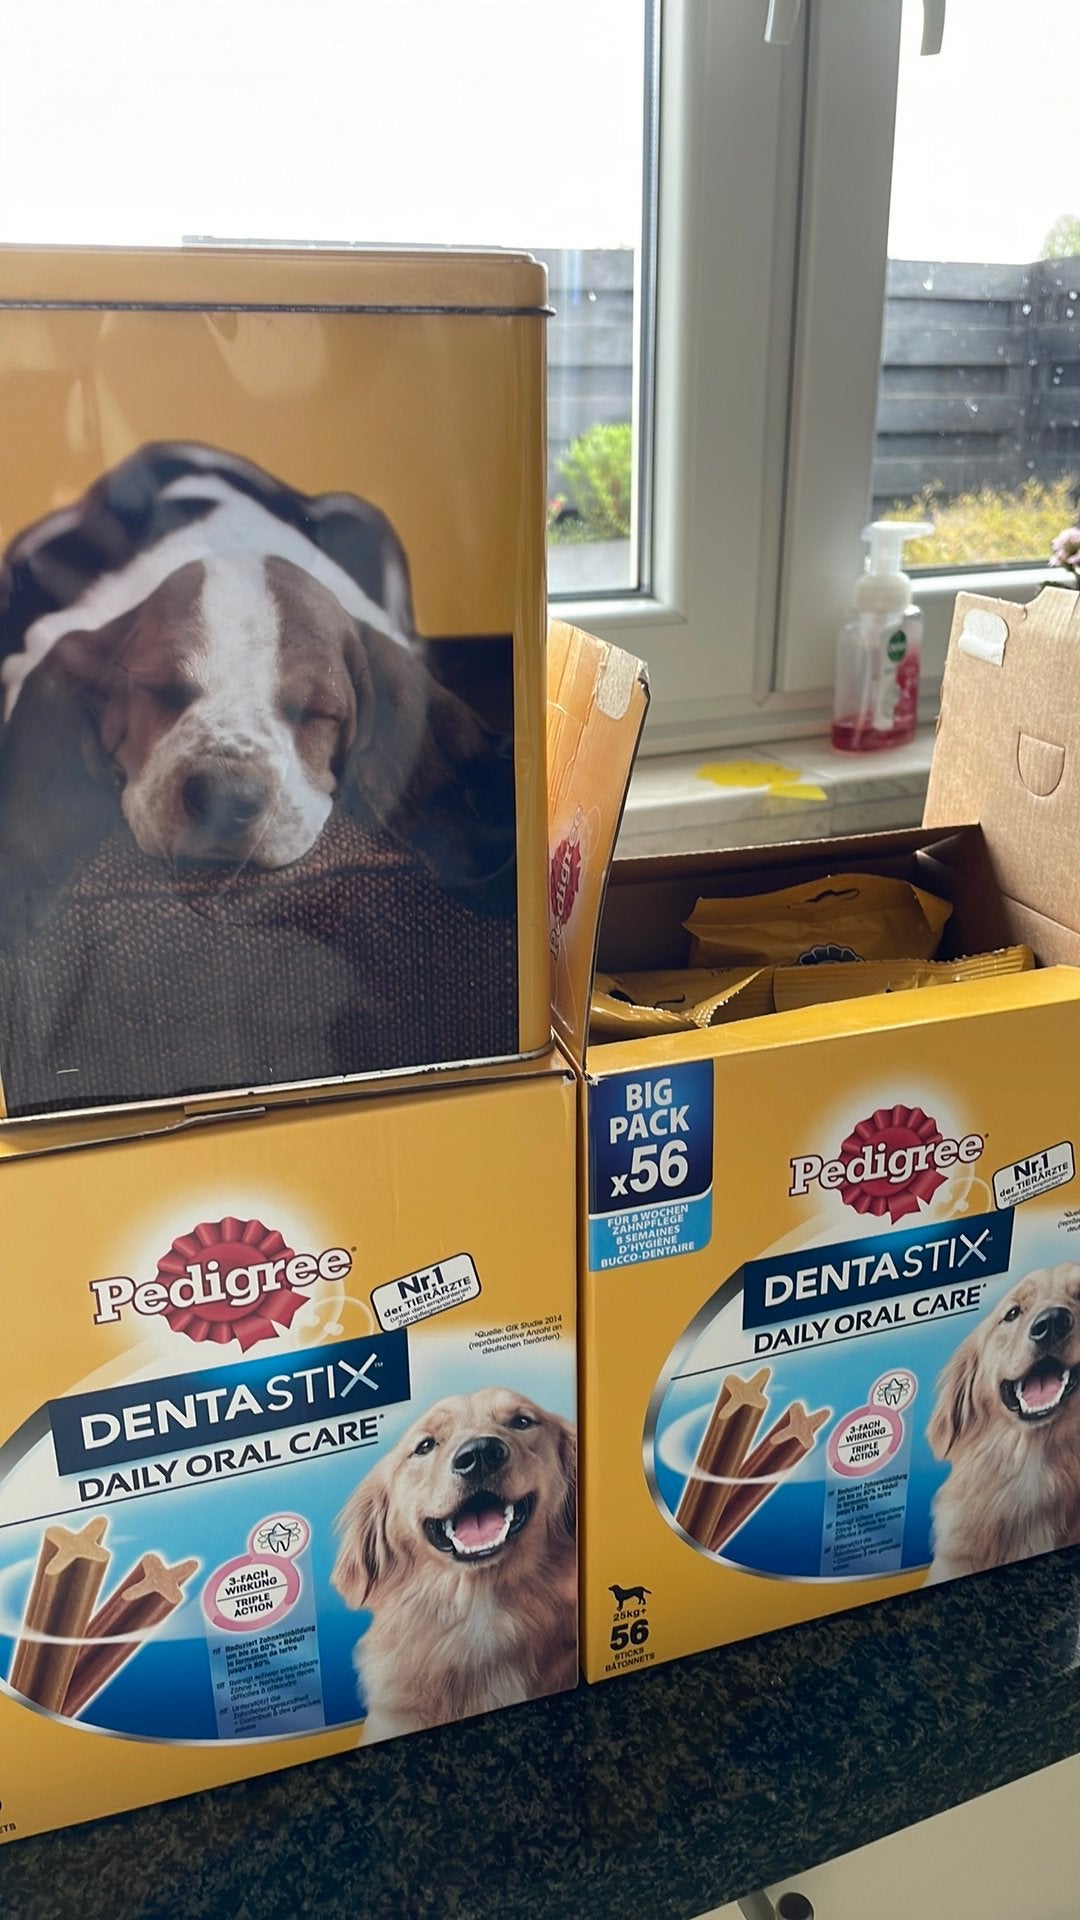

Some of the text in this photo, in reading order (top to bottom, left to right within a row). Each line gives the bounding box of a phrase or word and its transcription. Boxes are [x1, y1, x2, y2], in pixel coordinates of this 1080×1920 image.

[626, 1078, 673, 1112] BIG
[609, 1105, 690, 1144] PACK
[610, 1140, 689, 1197] x56
[789, 1133, 984, 1197] Pedigree
[1013, 1152, 1049, 1181] Nr.1
[1000, 1186, 1015, 1197] der
[1016, 1162, 1069, 1190] TIERÄRZTE
[608, 1204, 689, 1228] FÜR 8 WOCHEN
[612, 1214, 684, 1235] ZAHNPFLEGE
[616, 1225, 681, 1245] 8 SEMAINES
[619, 1235, 678, 1255] D'HYGIÈNE
[601, 1241, 695, 1268] BUCCO-DENTAIRE
[764, 1228, 990, 1307] DENTASTIX
[90, 1247, 353, 1325] Pedigree
[397, 1265, 445, 1300] Nr.1
[384, 1276, 472, 1318] der TIERÄRZTE
[520, 1319, 543, 1330] Studie
[544, 1314, 563, 1324] 2014
[526, 1325, 551, 1337] Anzahl
[754, 1318, 830, 1354] DAILY
[834, 1303, 906, 1334] ORAL
[482, 1341, 521, 1355] deutschen
[80, 1352, 379, 1450] DENTASTIX
[845, 1427, 886, 1443] WIRKUNG
[849, 1420, 881, 1434] 3-FACH
[849, 1449, 880, 1463] ACTION
[851, 1441, 879, 1454] TRIPLE
[78, 1459, 179, 1503] DAILY
[186, 1440, 281, 1478] ORAL
[225, 1576, 278, 1596] WIRKUNG
[228, 1569, 269, 1586] 3-FACH
[233, 1601, 273, 1618] ACTION
[235, 1592, 271, 1608] TRIPLE
[613, 1608, 647, 1621] 25kg+
[610, 1618, 649, 1651] 56
[605, 1652, 655, 1672] BÂTONNETS
[614, 1646, 645, 1661] STICKS
